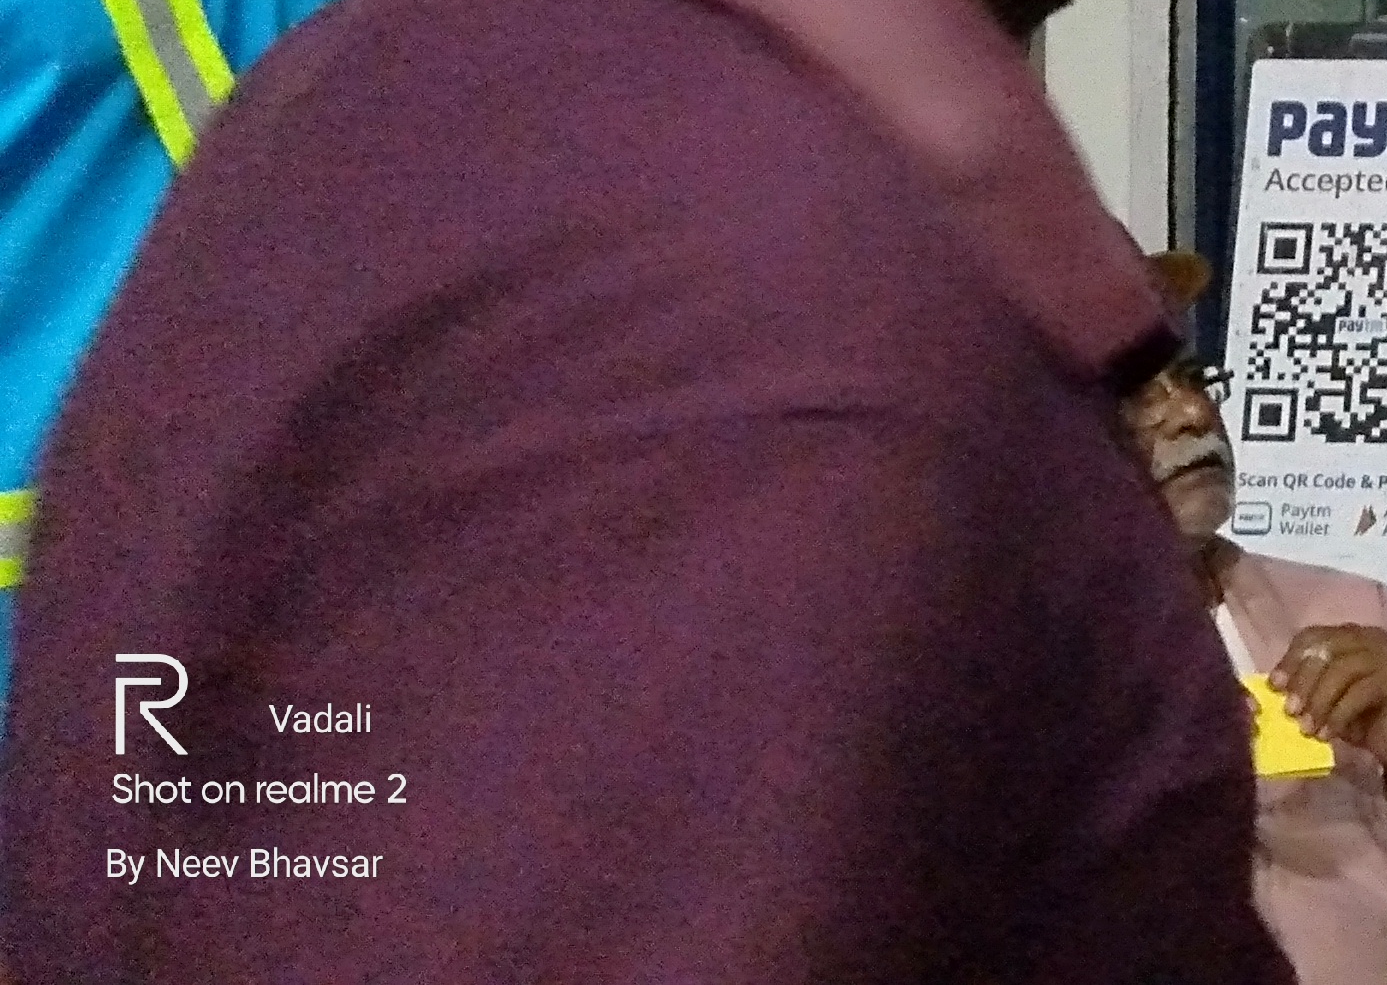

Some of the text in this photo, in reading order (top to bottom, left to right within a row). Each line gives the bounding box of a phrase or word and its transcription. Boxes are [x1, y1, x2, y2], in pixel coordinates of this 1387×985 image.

[1238, 471, 1277, 489] Scan
[1283, 473, 1309, 493] QR
[1313, 472, 1356, 490] Code
[1360, 473, 1374, 490] &
[1281, 502, 1332, 519] Paytm
[1279, 521, 1331, 536] Wallet
